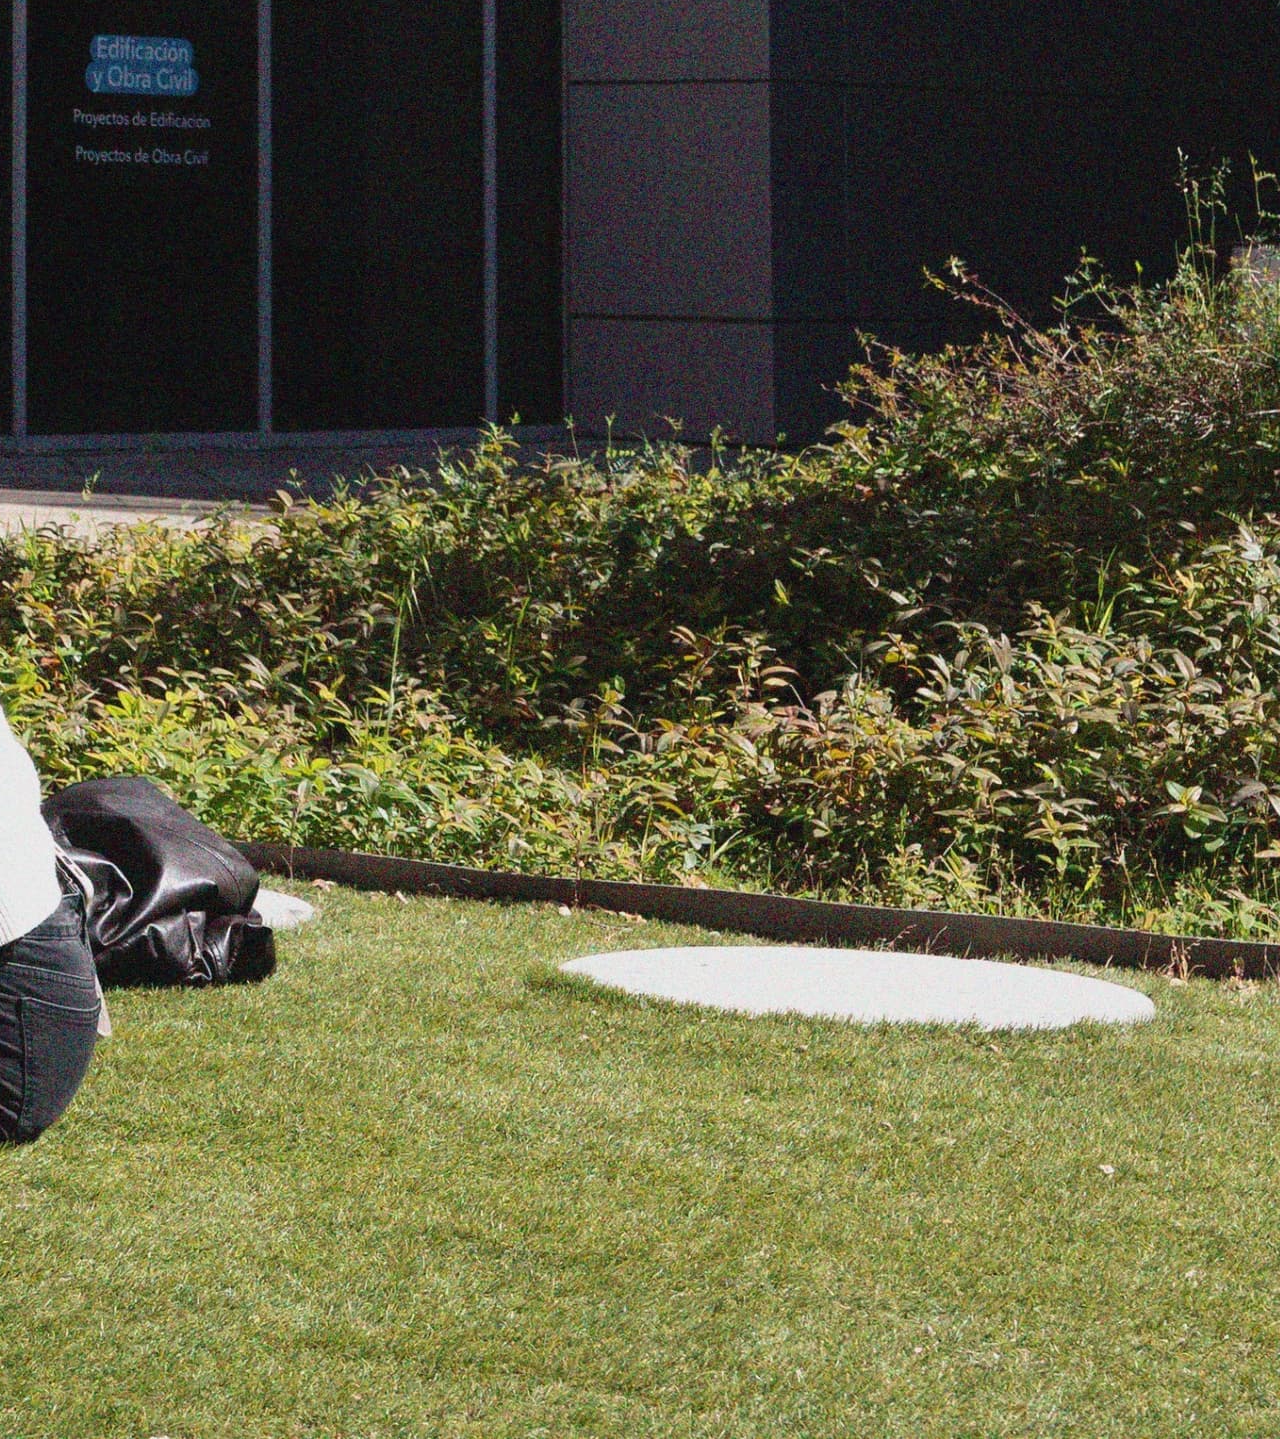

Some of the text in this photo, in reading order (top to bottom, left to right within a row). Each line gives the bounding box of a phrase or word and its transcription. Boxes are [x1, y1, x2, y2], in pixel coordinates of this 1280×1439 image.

[97, 36, 189, 62] Edificación
[92, 65, 192, 93] y Obra Civil
[73, 109, 129, 128] Proyectos
[132, 112, 146, 126] de
[75, 145, 209, 165] Proyectos de Obra Civil
